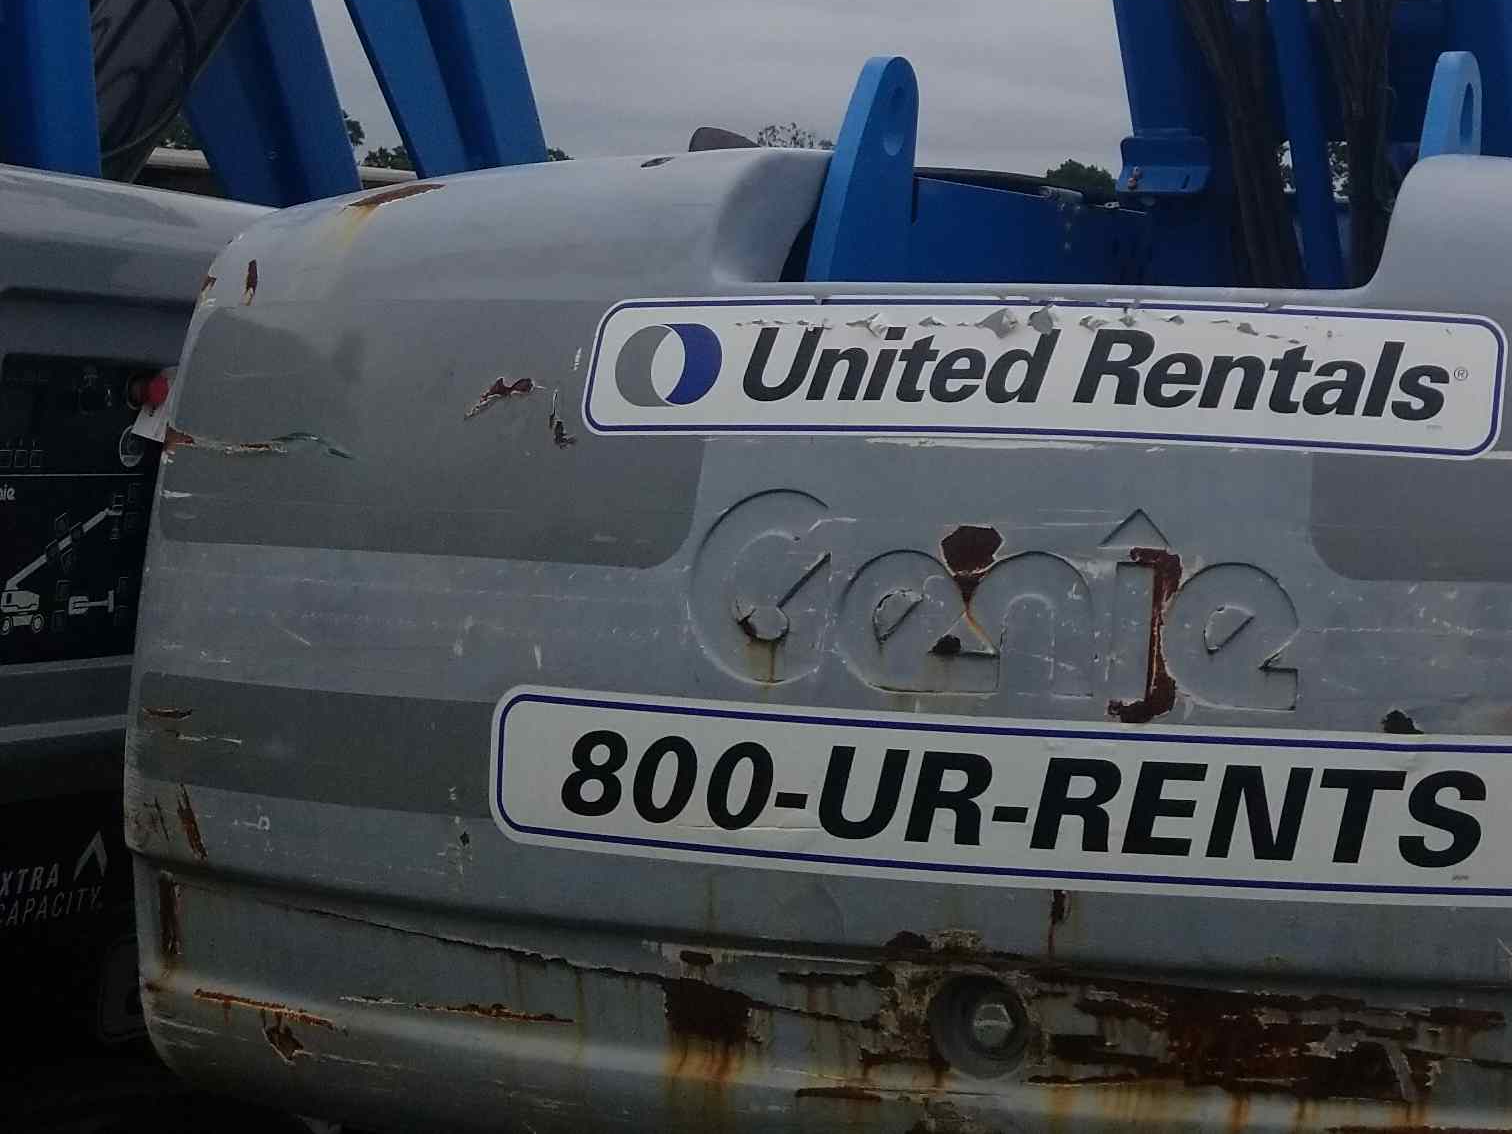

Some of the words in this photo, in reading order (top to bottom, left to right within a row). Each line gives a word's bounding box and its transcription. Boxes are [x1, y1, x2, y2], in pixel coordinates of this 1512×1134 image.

[742, 327, 1061, 404] United
[1072, 329, 1450, 421] Rentals
[560, 730, 1487, 868] 800-UR-RENTS
